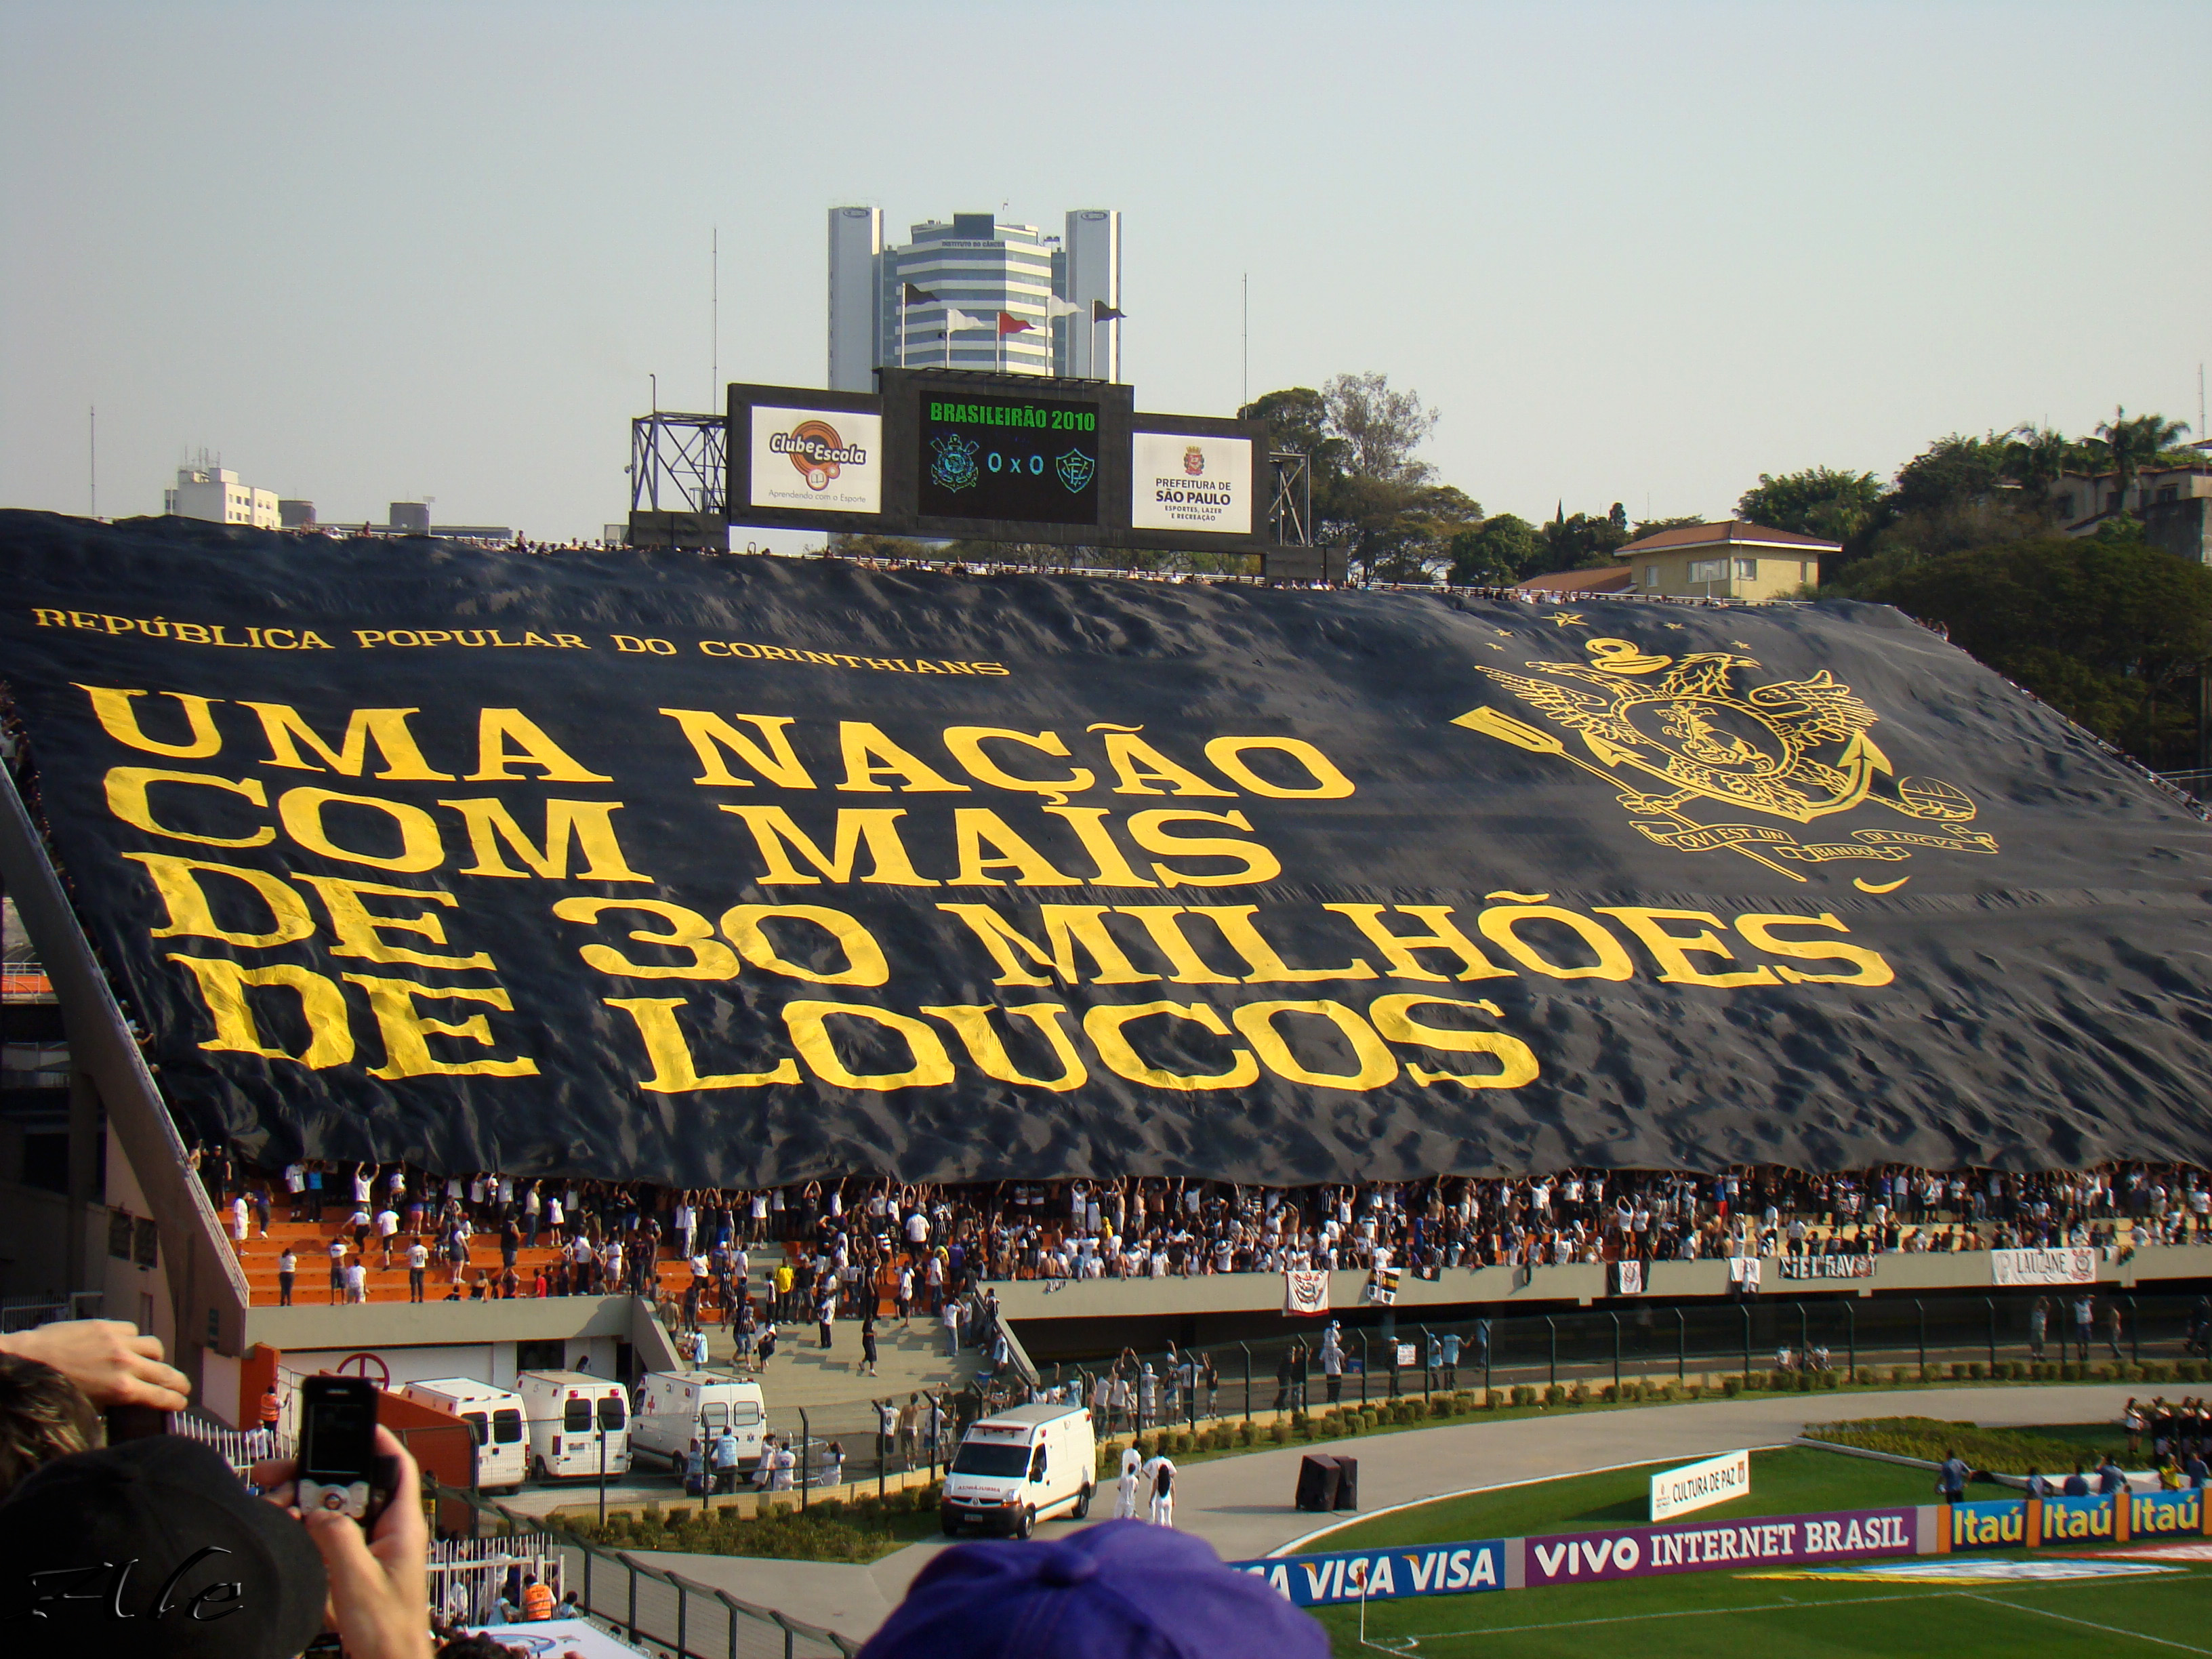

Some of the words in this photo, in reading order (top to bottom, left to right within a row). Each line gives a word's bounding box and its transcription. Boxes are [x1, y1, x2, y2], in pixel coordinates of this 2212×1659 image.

[930, 403, 1047, 428] BRASILEIRÃO
[1052, 411, 1095, 431] 2010
[988, 453, 1002, 472] 0
[1010, 458, 1021, 473] x
[1029, 455, 1044, 475] 0
[769, 489, 813, 499] Aprendendo
[840, 494, 866, 503] Esporte
[1155, 489, 1184, 503] SÃO
[1187, 492, 1231, 506] PAULO
[1156, 478, 1216, 490] PREFEITURA
[1218, 482, 1231, 491] DE
[1165, 506, 1200, 514] ESPORTES,
[33, 609, 334, 649] REPÚBLICA
[353, 630, 591, 649] POPULAR
[611, 635, 677, 655] DO
[699, 641, 1010, 675] CORINTHIANS
[70, 682, 614, 783] UMA
[659, 708, 1355, 806] NAÇÃO
[103, 766, 655, 883] COM
[718, 804, 1281, 888] MAIS
[1714, 828, 1754, 840] EST
[1757, 830, 1784, 840] UN
[1865, 832, 1888, 841] DI
[1811, 846, 1876, 857] BANDO
[121, 853, 497, 970] DE
[552, 897, 889, 987] 30
[935, 890, 1895, 989] MILHÕES
[166, 953, 541, 1080] DE
[603, 994, 1540, 1093] LOUCOS
[1673, 1475, 1708, 1502] CULTURA
[1710, 1471, 1720, 1492] DE
[1721, 1467, 1736, 1489] PAZ
[1954, 1507, 2023, 1544] Itaú
[2043, 1502, 2112, 1538] Itaú
[2131, 1495, 2199, 1533] Itaú
[1534, 1536, 1640, 1577] VIVO
[1650, 1523, 1796, 1567] INTERNET
[1805, 1516, 1909, 1555] BRASIL
[1299, 1556, 1395, 1600] VISA
[1402, 1548, 1496, 1591] VISA
